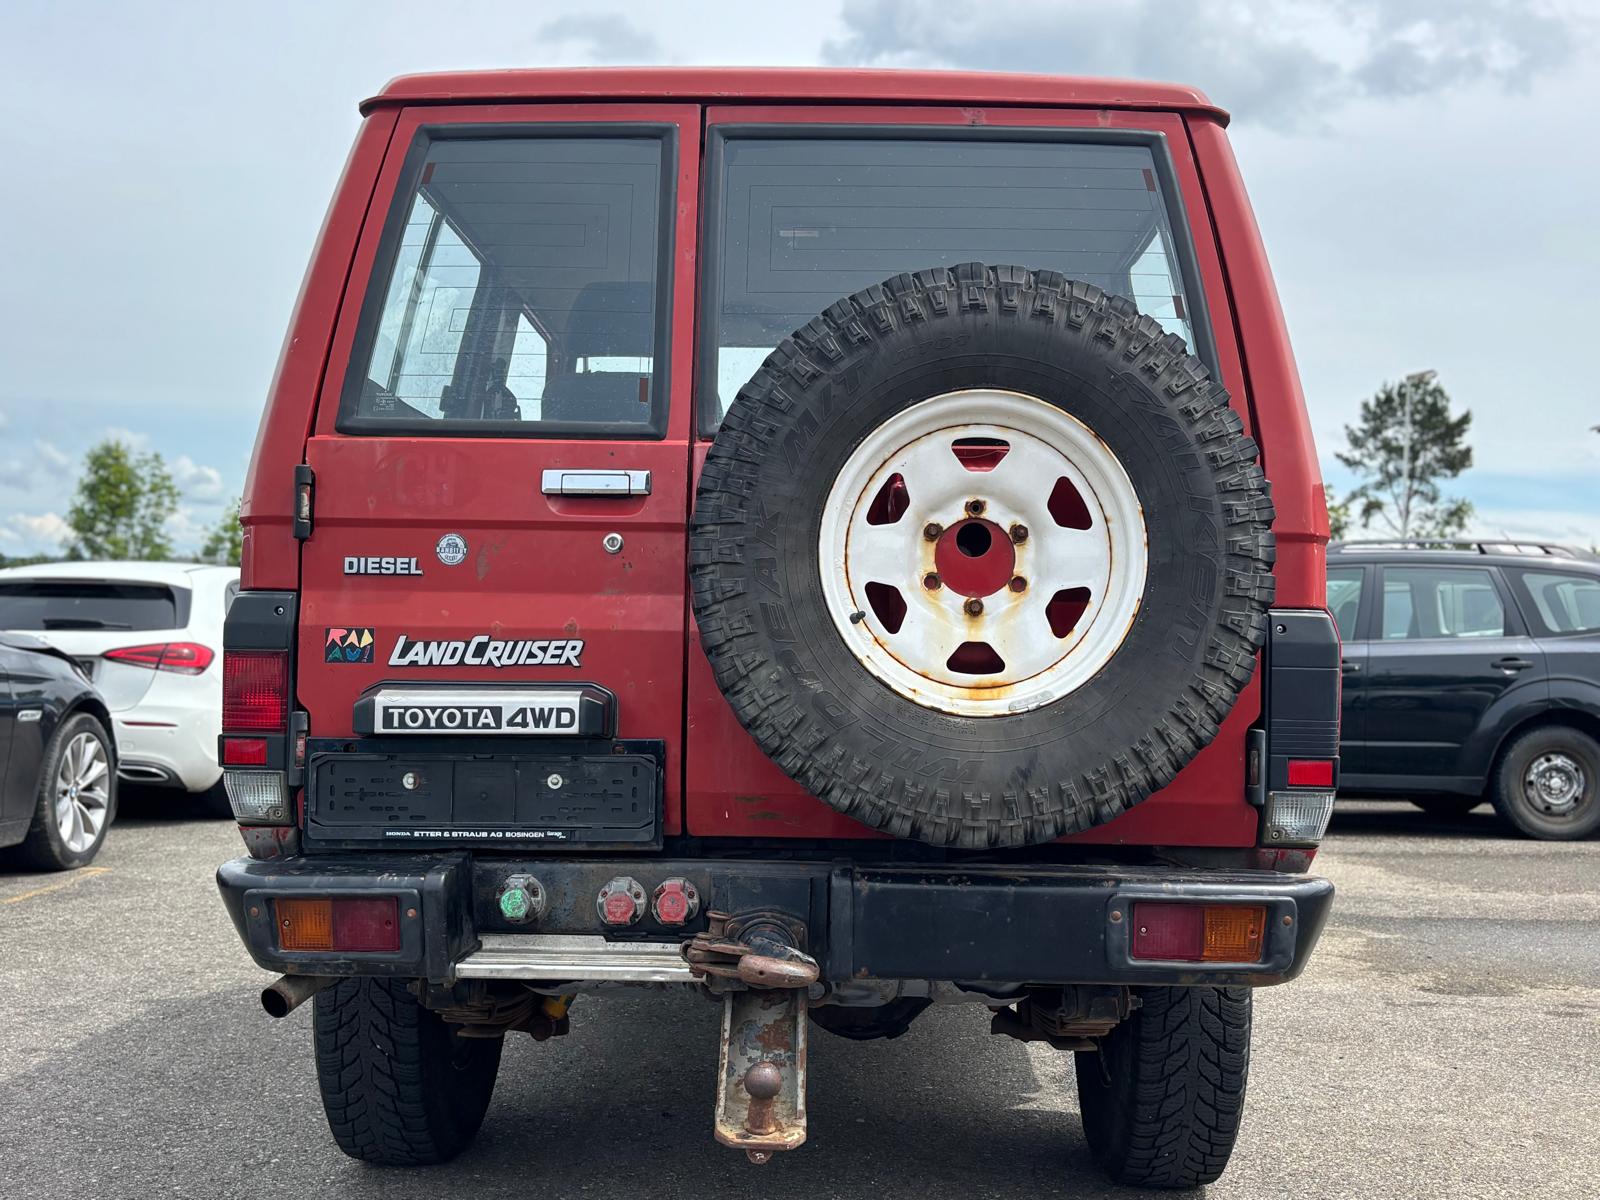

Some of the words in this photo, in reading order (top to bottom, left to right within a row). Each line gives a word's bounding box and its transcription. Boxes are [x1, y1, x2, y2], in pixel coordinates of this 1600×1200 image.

[344, 557, 423, 575] DIESEL
[388, 708, 494, 728] TOYOTA
[506, 707, 576, 729] 4WD
